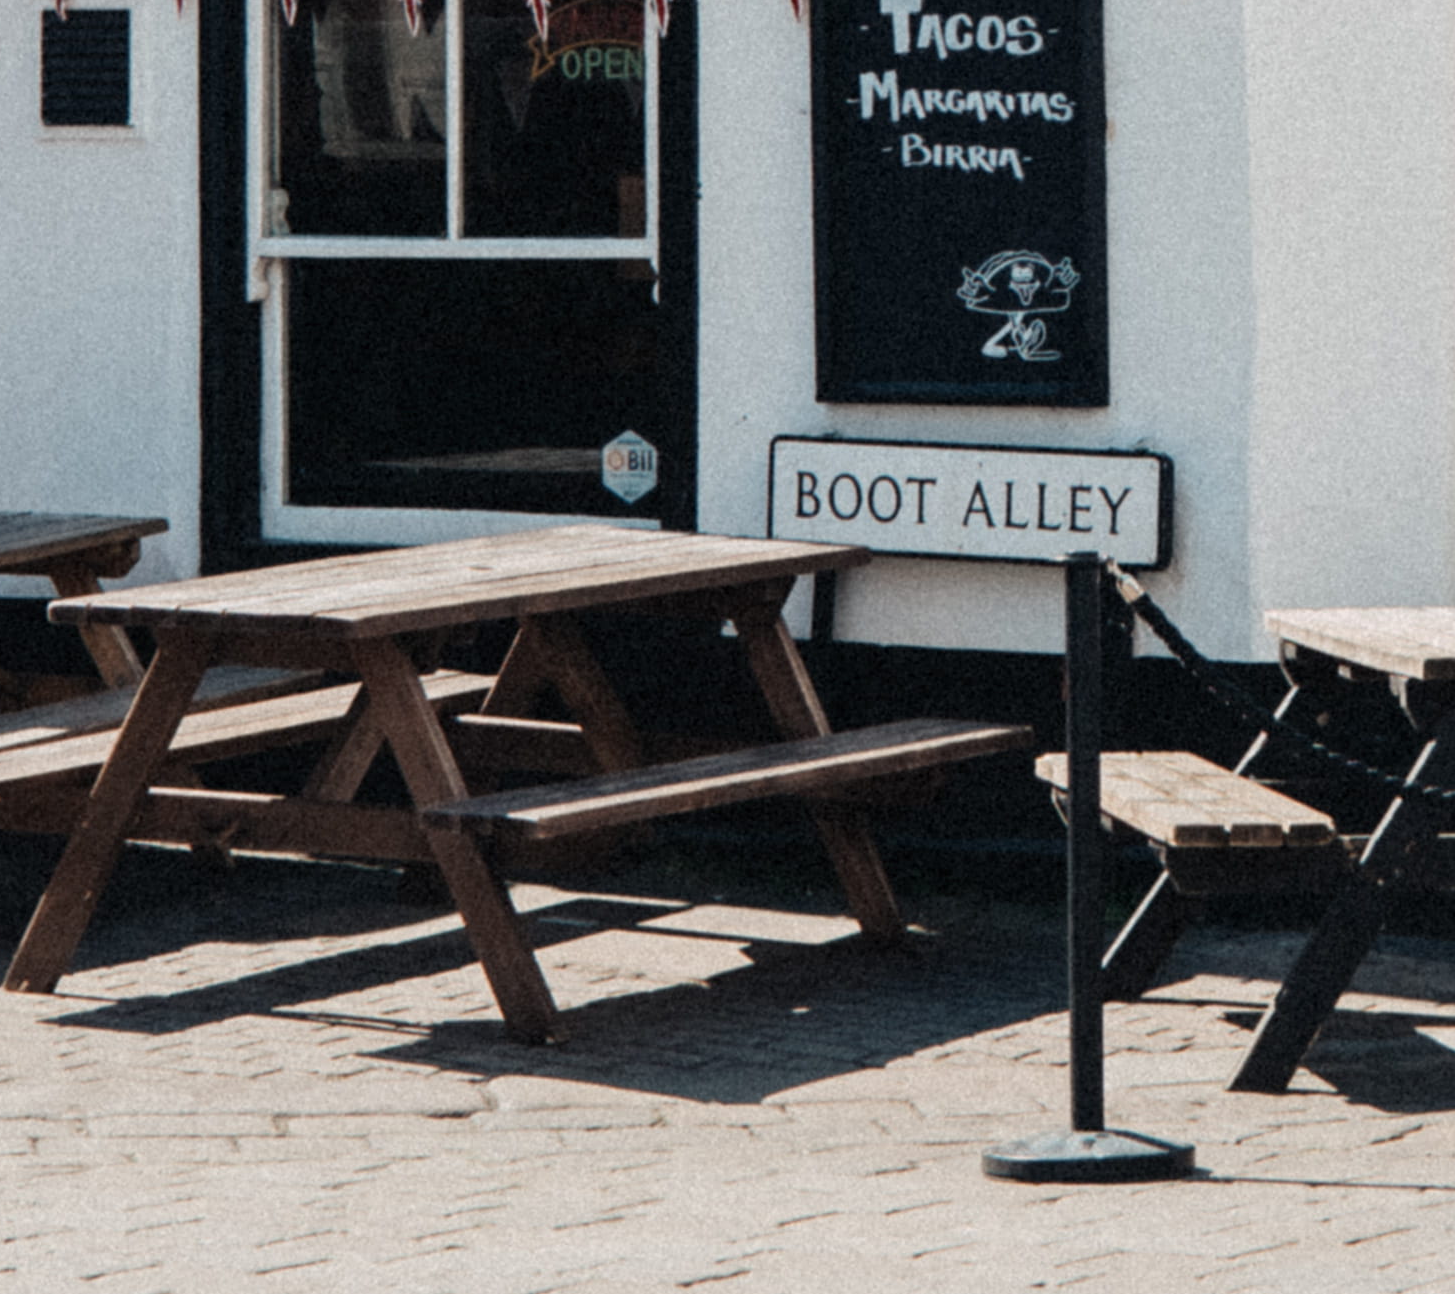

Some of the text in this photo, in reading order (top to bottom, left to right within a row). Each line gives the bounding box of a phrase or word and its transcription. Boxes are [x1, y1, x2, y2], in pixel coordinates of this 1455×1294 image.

[562, 47, 643, 80] OPEN
[795, 469, 1135, 535] BOOT ALLEY
